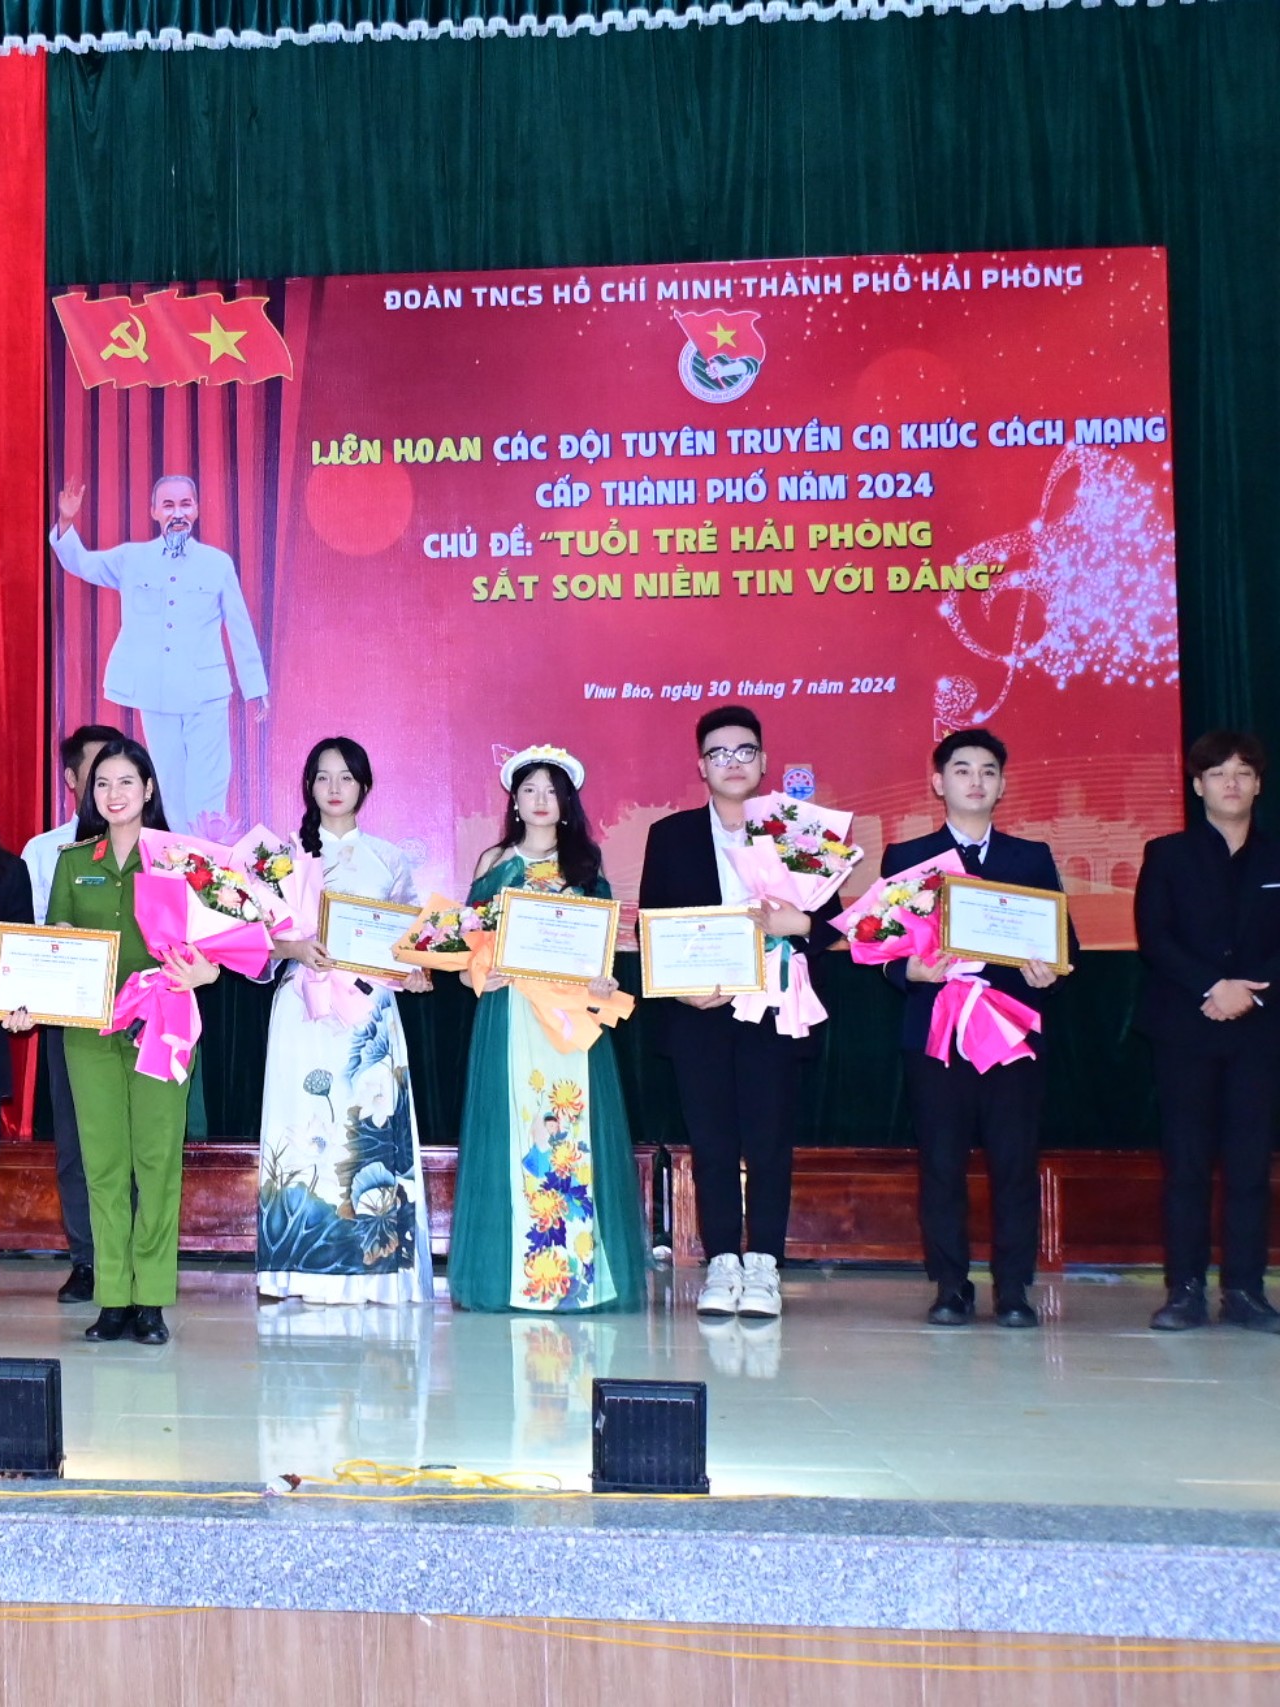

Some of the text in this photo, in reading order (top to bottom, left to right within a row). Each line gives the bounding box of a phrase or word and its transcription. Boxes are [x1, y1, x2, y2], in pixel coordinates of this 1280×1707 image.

[383, 262, 1083, 310] ĐOÀN TNCS HỒ CHÍ MINH THÀNH PHỐ HẢI PHÒNG
[311, 415, 1167, 466] LIÊN HOAN CÁC ĐỘI TUYÊN TRUYỀN CA KHÚC CÁCH MẠNG
[535, 468, 933, 508] CẤP THÀNH PHỐ NĂM 2024
[423, 525, 477, 559] CHỦ
[652, 520, 718, 553] TRẺ
[730, 518, 795, 551] HẢI
[808, 518, 932, 549] PHÒNG
[472, 567, 539, 601] SẮT
[552, 573, 622, 599] SON
[634, 563, 720, 598] NIỀM
[732, 569, 793, 595] TIN
[806, 562, 874, 593] VỚI
[660, 681, 703, 702] ngày
[707, 680, 732, 697] 30
[737, 679, 786, 700] tháng
[791, 678, 804, 695] 7
[806, 678, 844, 695] năm
[849, 676, 896, 694] 2024
